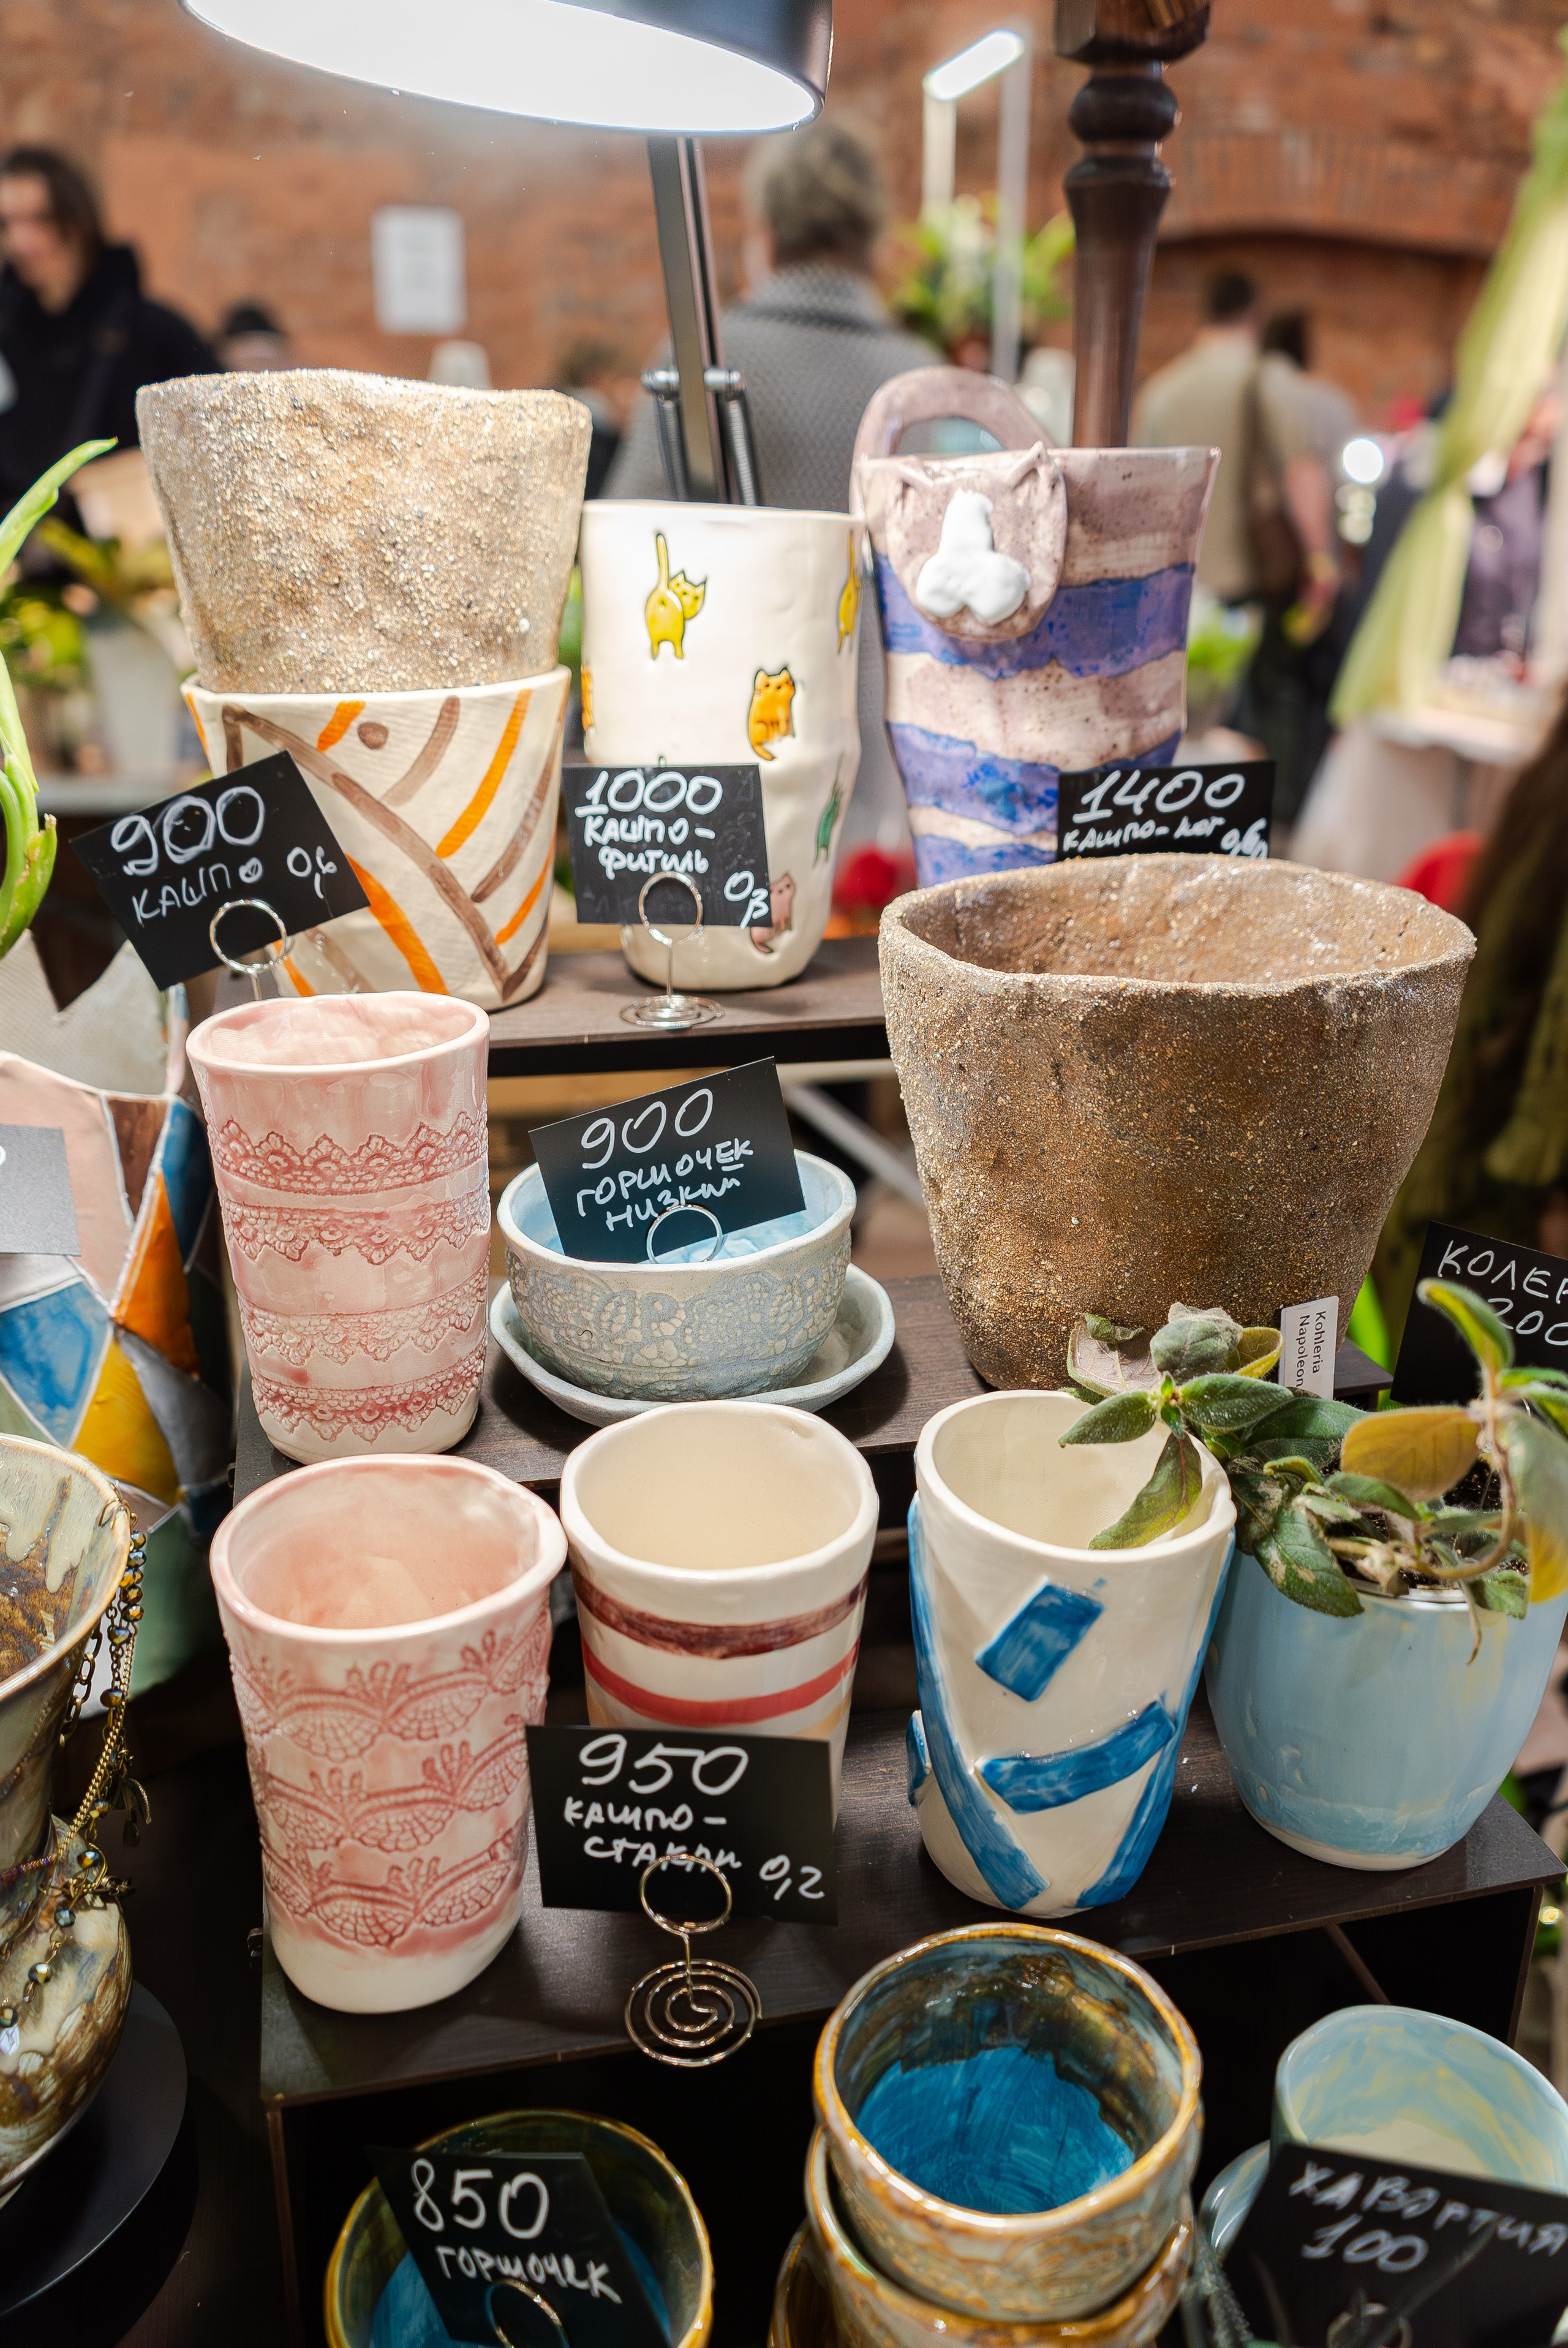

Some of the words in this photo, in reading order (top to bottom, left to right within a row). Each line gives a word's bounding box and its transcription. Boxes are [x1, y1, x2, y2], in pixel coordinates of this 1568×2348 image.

[575, 770, 723, 817] 1000
[1072, 769, 1245, 823] 1400
[110, 785, 266, 876] 900
[581, 1089, 713, 1169] 900
[1296, 1315, 1311, 1387] Napoleon
[1313, 1311, 1327, 1373] Kohleria
[579, 1734, 748, 1795] 950
[759, 1854, 825, 1900] 0,2
[410, 2158, 550, 2240] 850
[1302, 2213, 1430, 2273] 100
